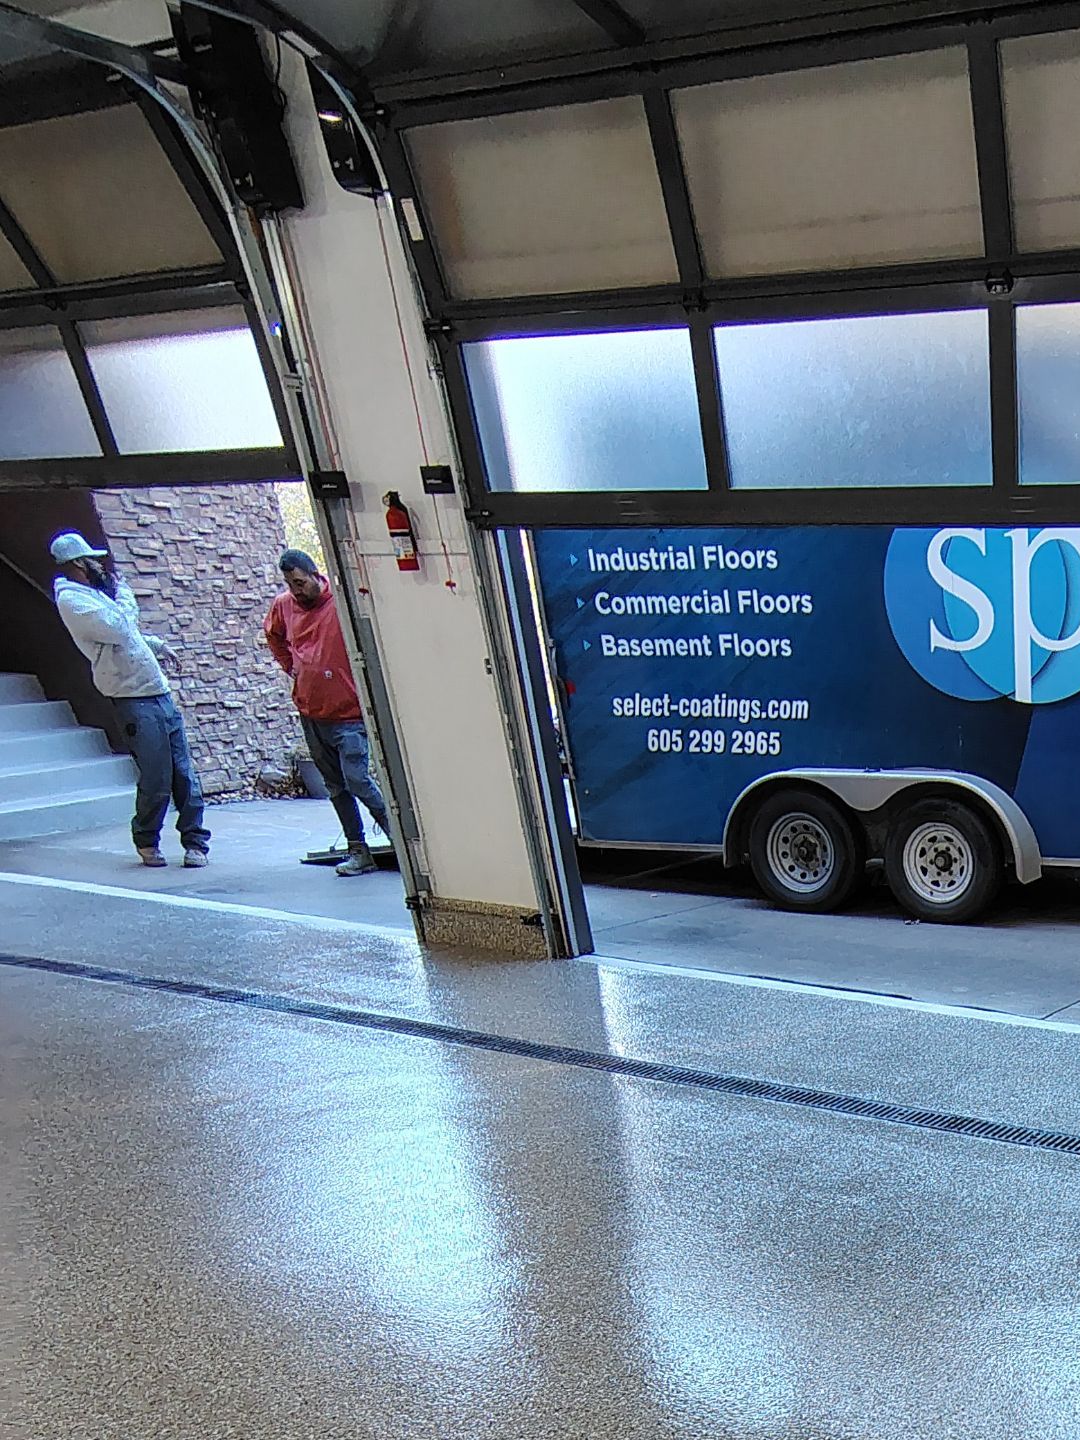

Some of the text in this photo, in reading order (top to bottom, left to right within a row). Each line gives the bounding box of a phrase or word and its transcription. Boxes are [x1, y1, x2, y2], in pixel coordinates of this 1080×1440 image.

[588, 545, 779, 572] Industrial Floors
[594, 589, 813, 616] Commercial Floors
[601, 632, 793, 657] Basement Floors
[612, 693, 810, 723] select-coatings.com
[647, 729, 781, 755] 605 299 2965
